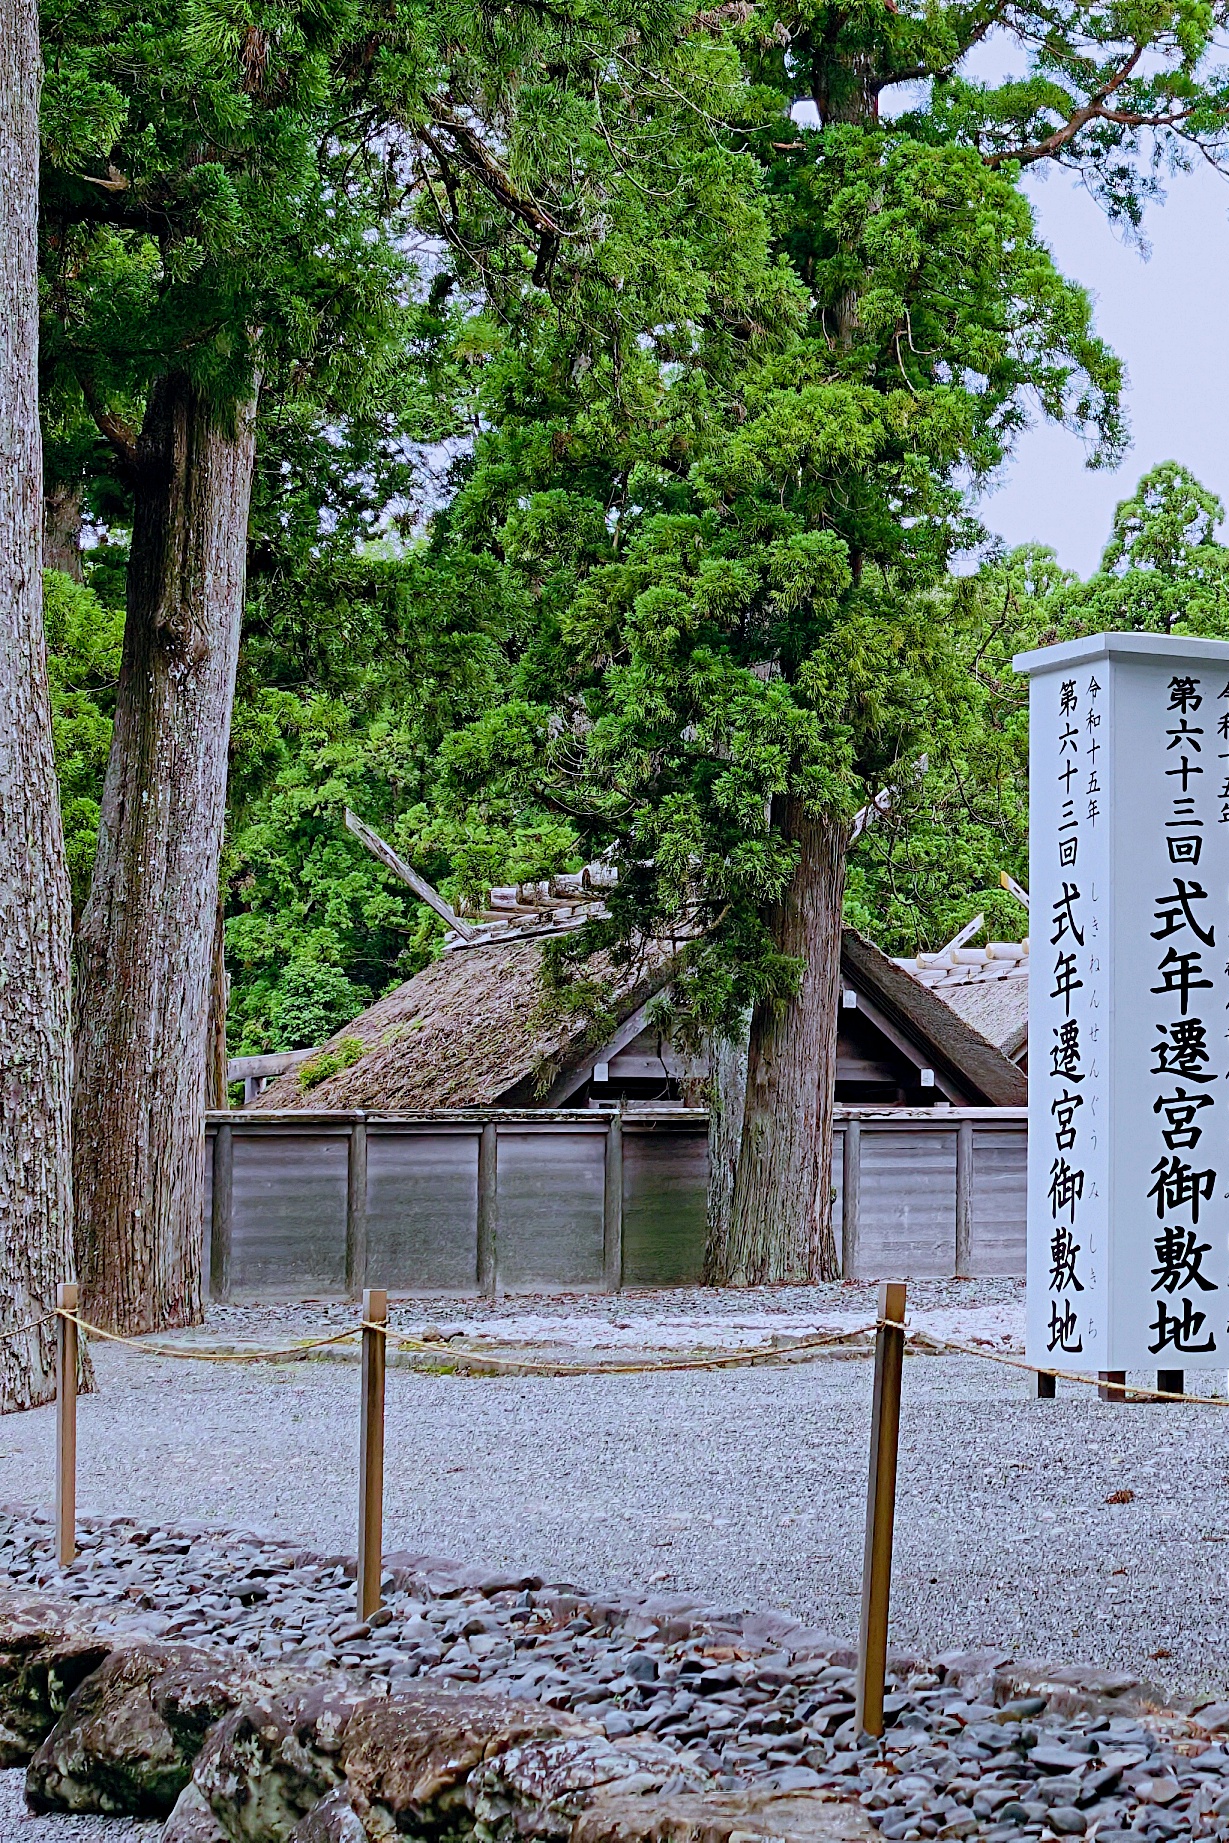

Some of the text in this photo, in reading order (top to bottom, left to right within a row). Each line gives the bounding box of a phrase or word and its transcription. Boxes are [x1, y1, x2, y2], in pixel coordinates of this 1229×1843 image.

[1086, 675, 1102, 828] 令和十五年
